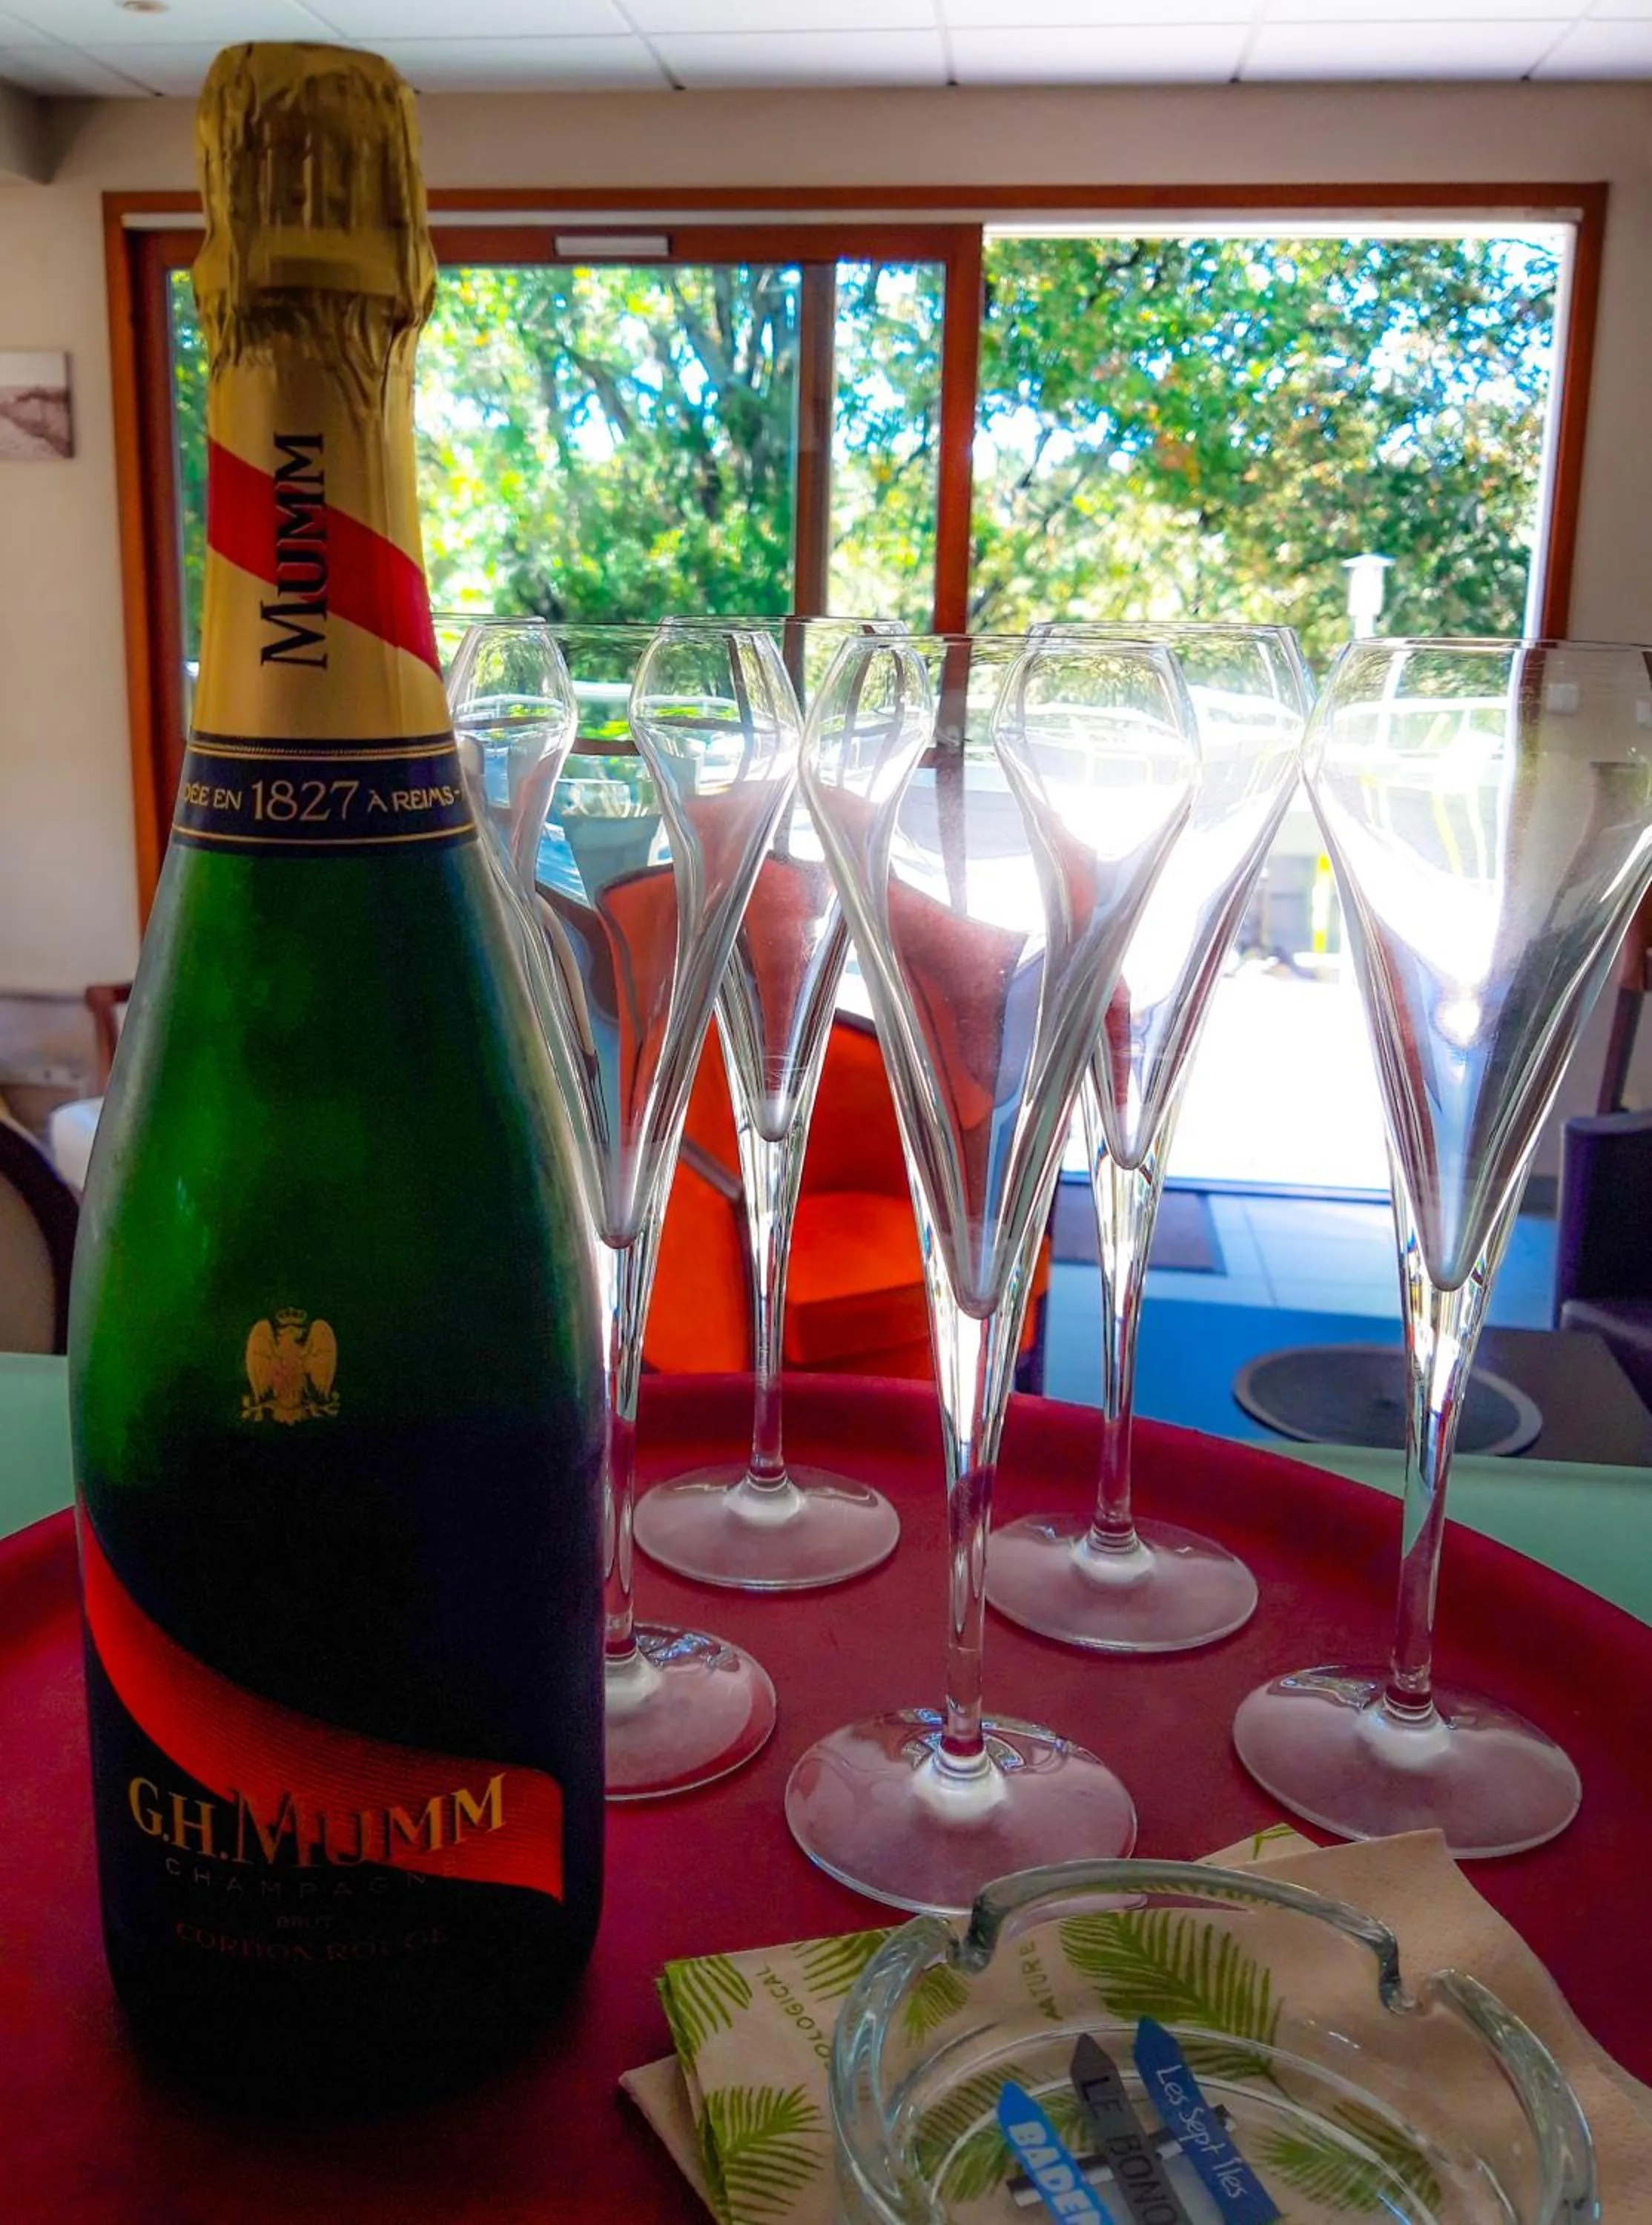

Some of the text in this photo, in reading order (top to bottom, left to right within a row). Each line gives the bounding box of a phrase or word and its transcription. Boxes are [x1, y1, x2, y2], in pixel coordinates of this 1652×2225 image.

[213, 787, 243, 811] EN
[251, 779, 360, 822] 1827
[756, 1965, 831, 2071] OLOGICAL
[1083, 2076, 1124, 2120] LE
[1155, 2064, 1189, 2106] Les
